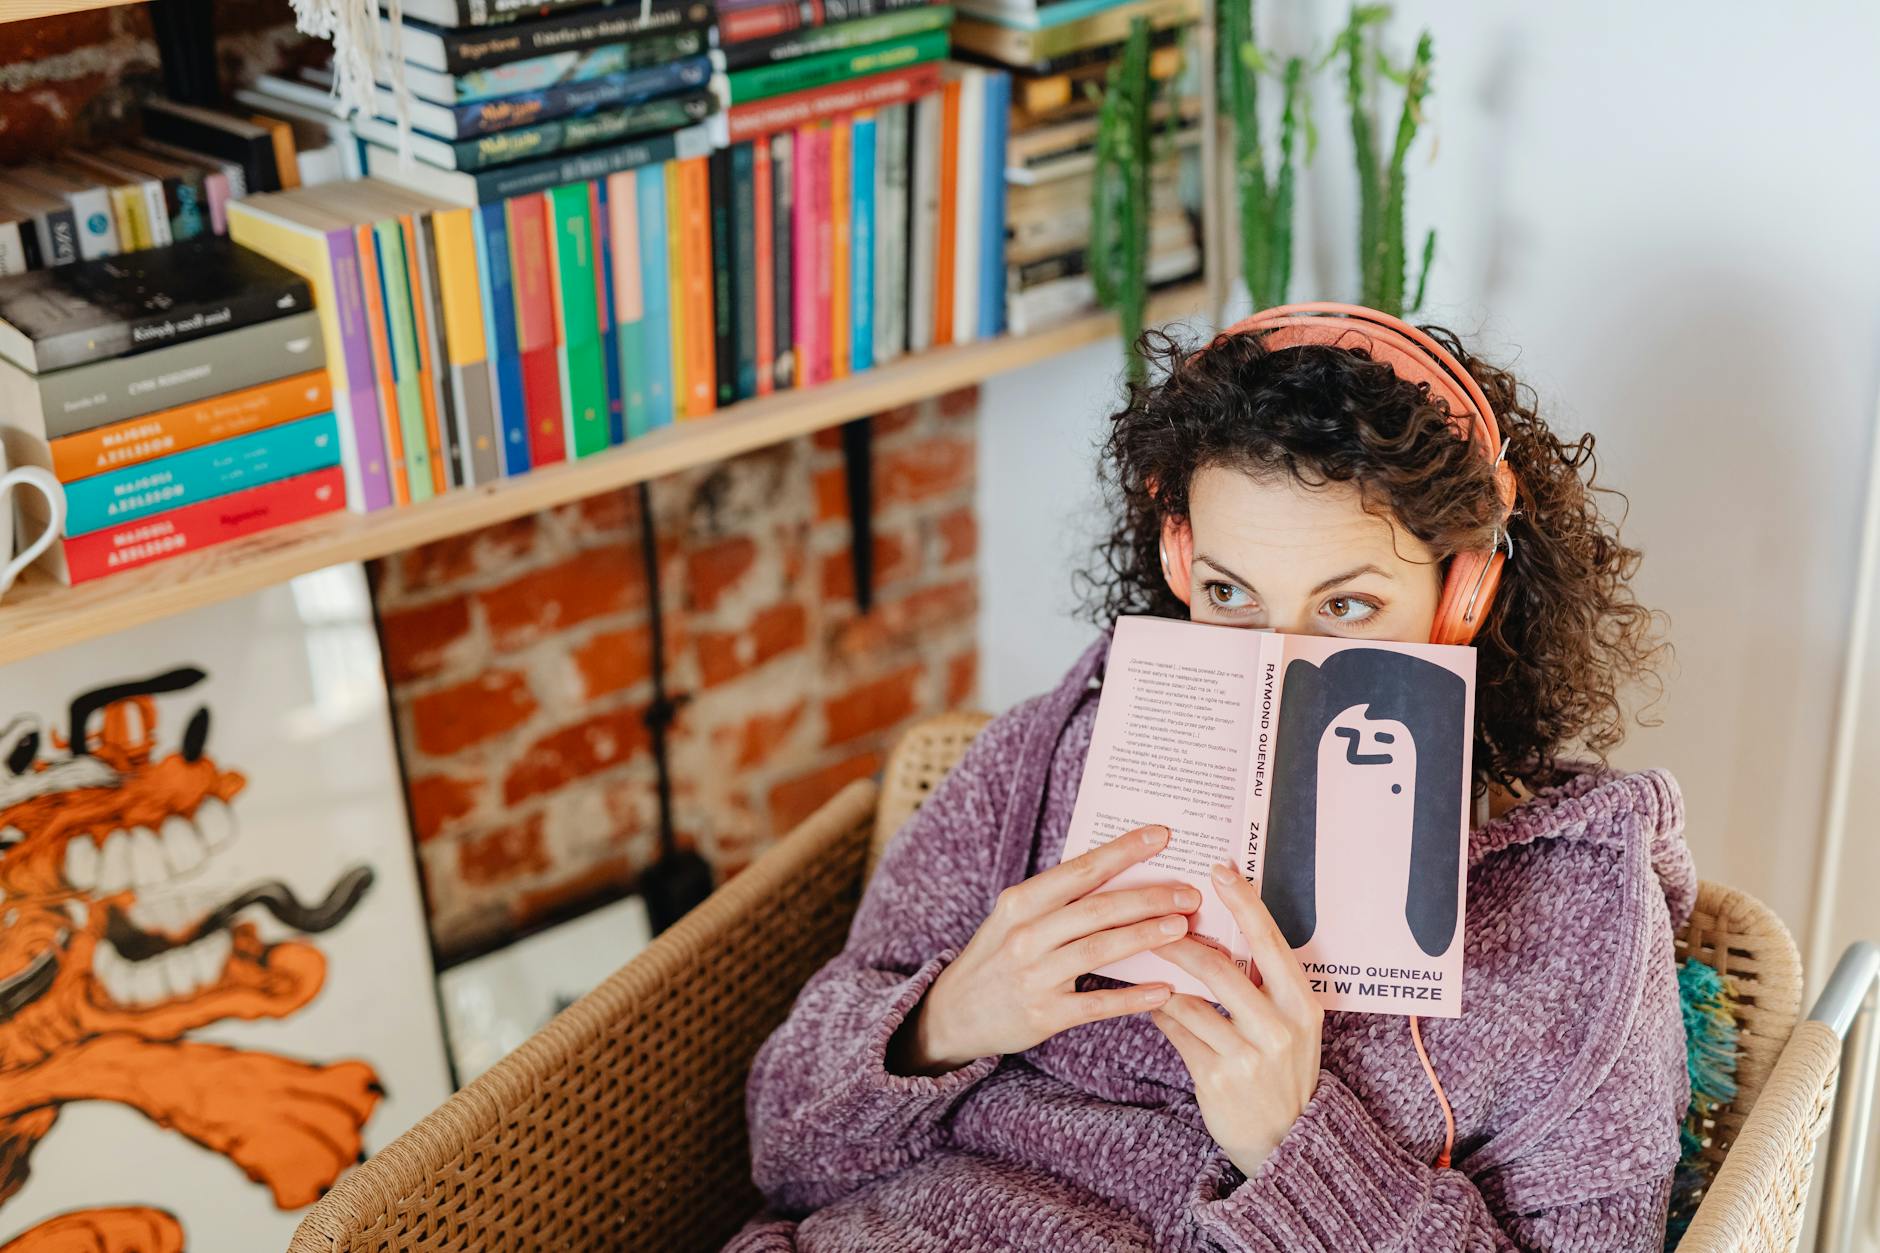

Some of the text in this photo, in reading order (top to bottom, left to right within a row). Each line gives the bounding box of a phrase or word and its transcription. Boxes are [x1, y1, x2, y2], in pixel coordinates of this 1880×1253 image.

[1254, 664, 1274, 797] RAYMOND QUENEAU
[1248, 822, 1259, 855] ZAZI
[1247, 859, 1256, 871] W
[1302, 962, 1443, 981] YMOND QUENEAU
[1310, 980, 1442, 1000] ZI W METRZE
